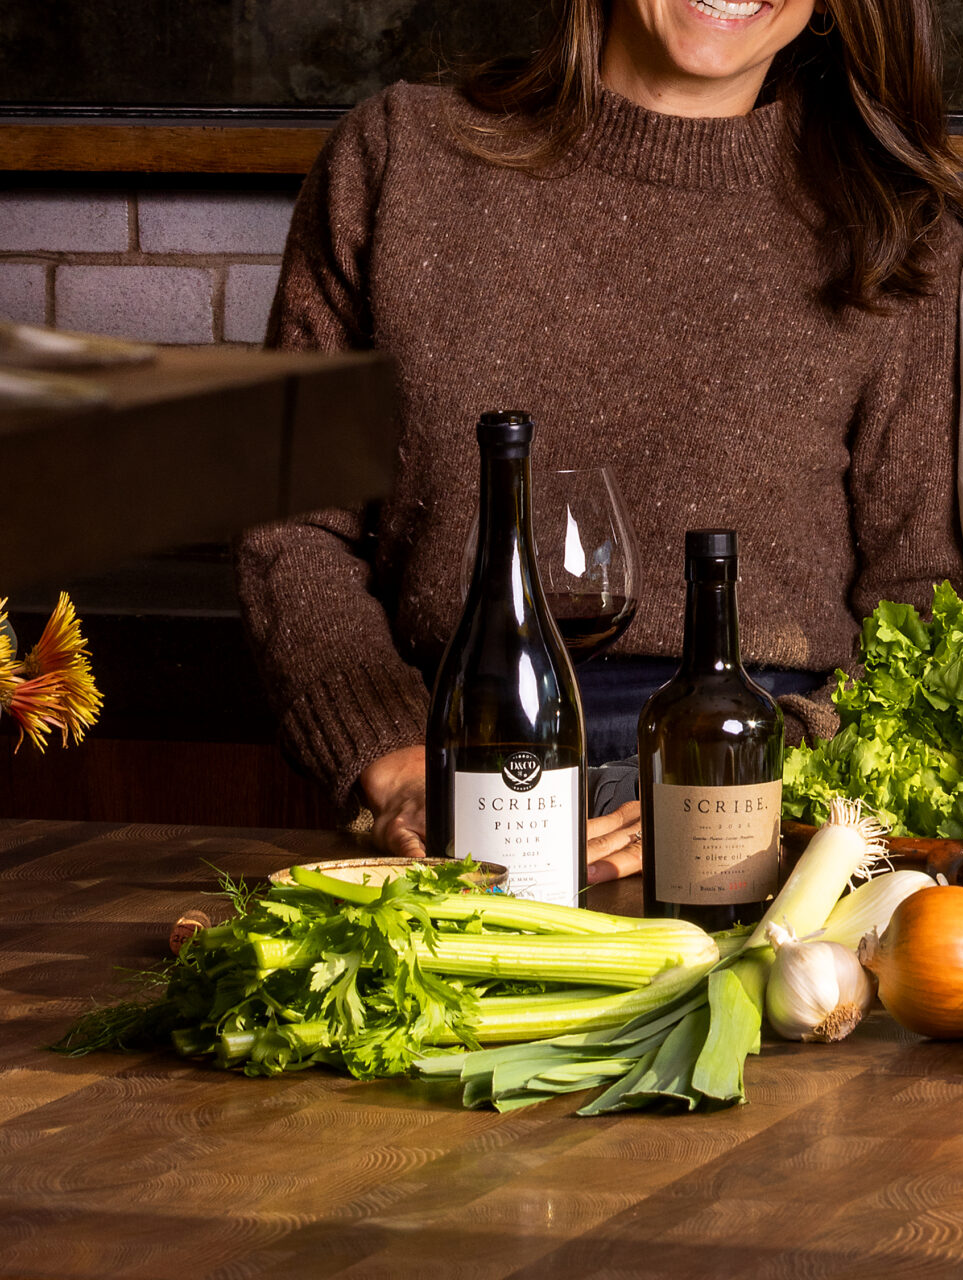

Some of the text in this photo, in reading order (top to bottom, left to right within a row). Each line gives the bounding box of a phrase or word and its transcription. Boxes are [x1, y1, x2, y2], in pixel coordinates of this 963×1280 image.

[494, 819, 549, 831] PINOT
[504, 836, 540, 845] NOIR
[705, 852, 742, 861] olive oil
